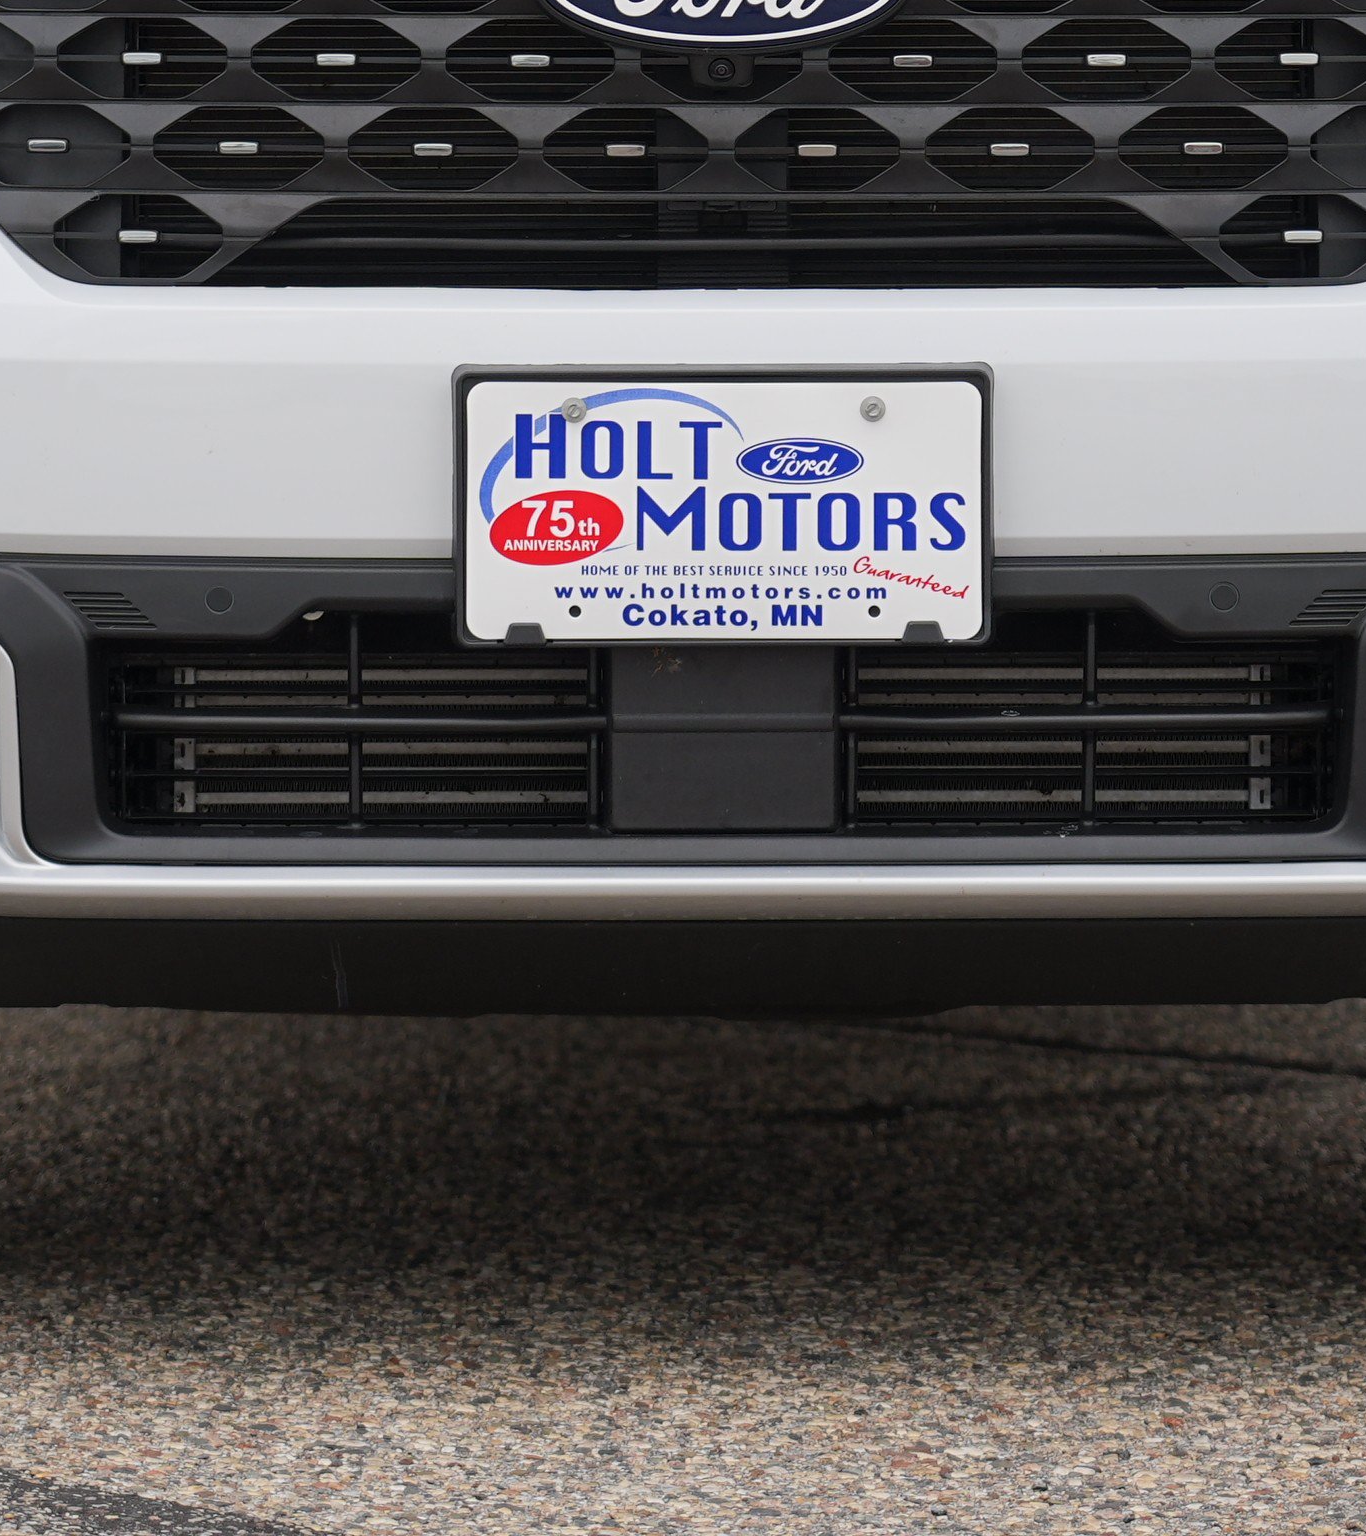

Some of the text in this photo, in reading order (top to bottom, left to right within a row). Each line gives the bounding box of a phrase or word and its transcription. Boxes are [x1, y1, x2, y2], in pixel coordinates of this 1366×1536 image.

[515, 413, 722, 480] HOLT
[761, 444, 839, 476] Ford
[521, 500, 600, 538] 75th
[637, 486, 966, 552] MOTORS
[503, 539, 599, 552] ANNIVERSARY
[581, 565, 848, 577] HOME OF THE BEST SERVICE SINCE 1950
[853, 556, 970, 599] Guaranteed
[554, 583, 887, 600] www.holtmotors.com
[622, 603, 823, 631] Cokato, MN
